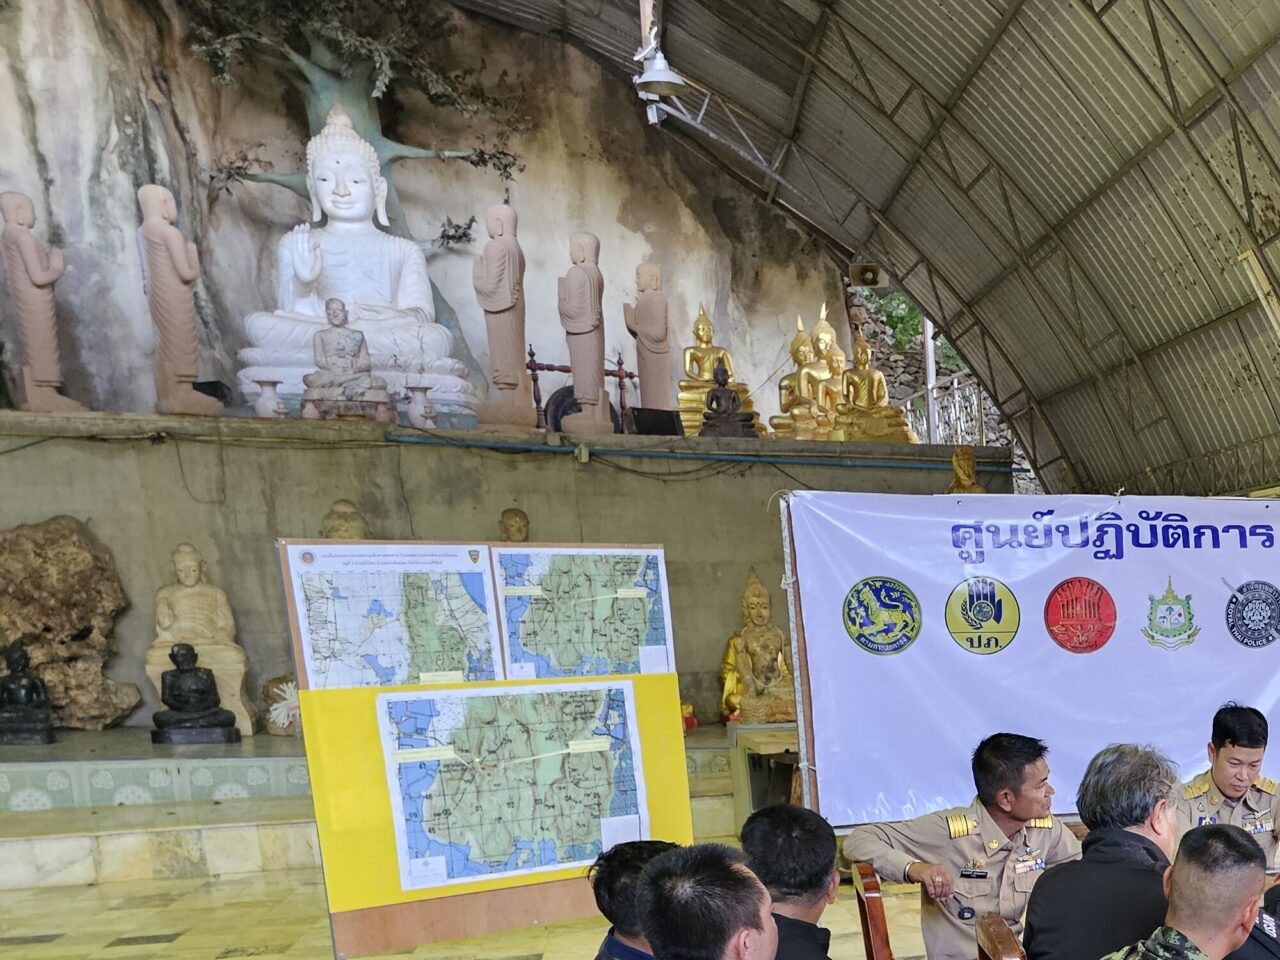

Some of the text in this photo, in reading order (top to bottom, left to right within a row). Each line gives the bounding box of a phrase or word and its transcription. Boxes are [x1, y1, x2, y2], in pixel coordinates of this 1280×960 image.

[951, 509, 1275, 564] ศูนย์ปฏิบัติการ
[966, 635, 1003, 649] ปภ.
[1243, 638, 1267, 647] POLICE
